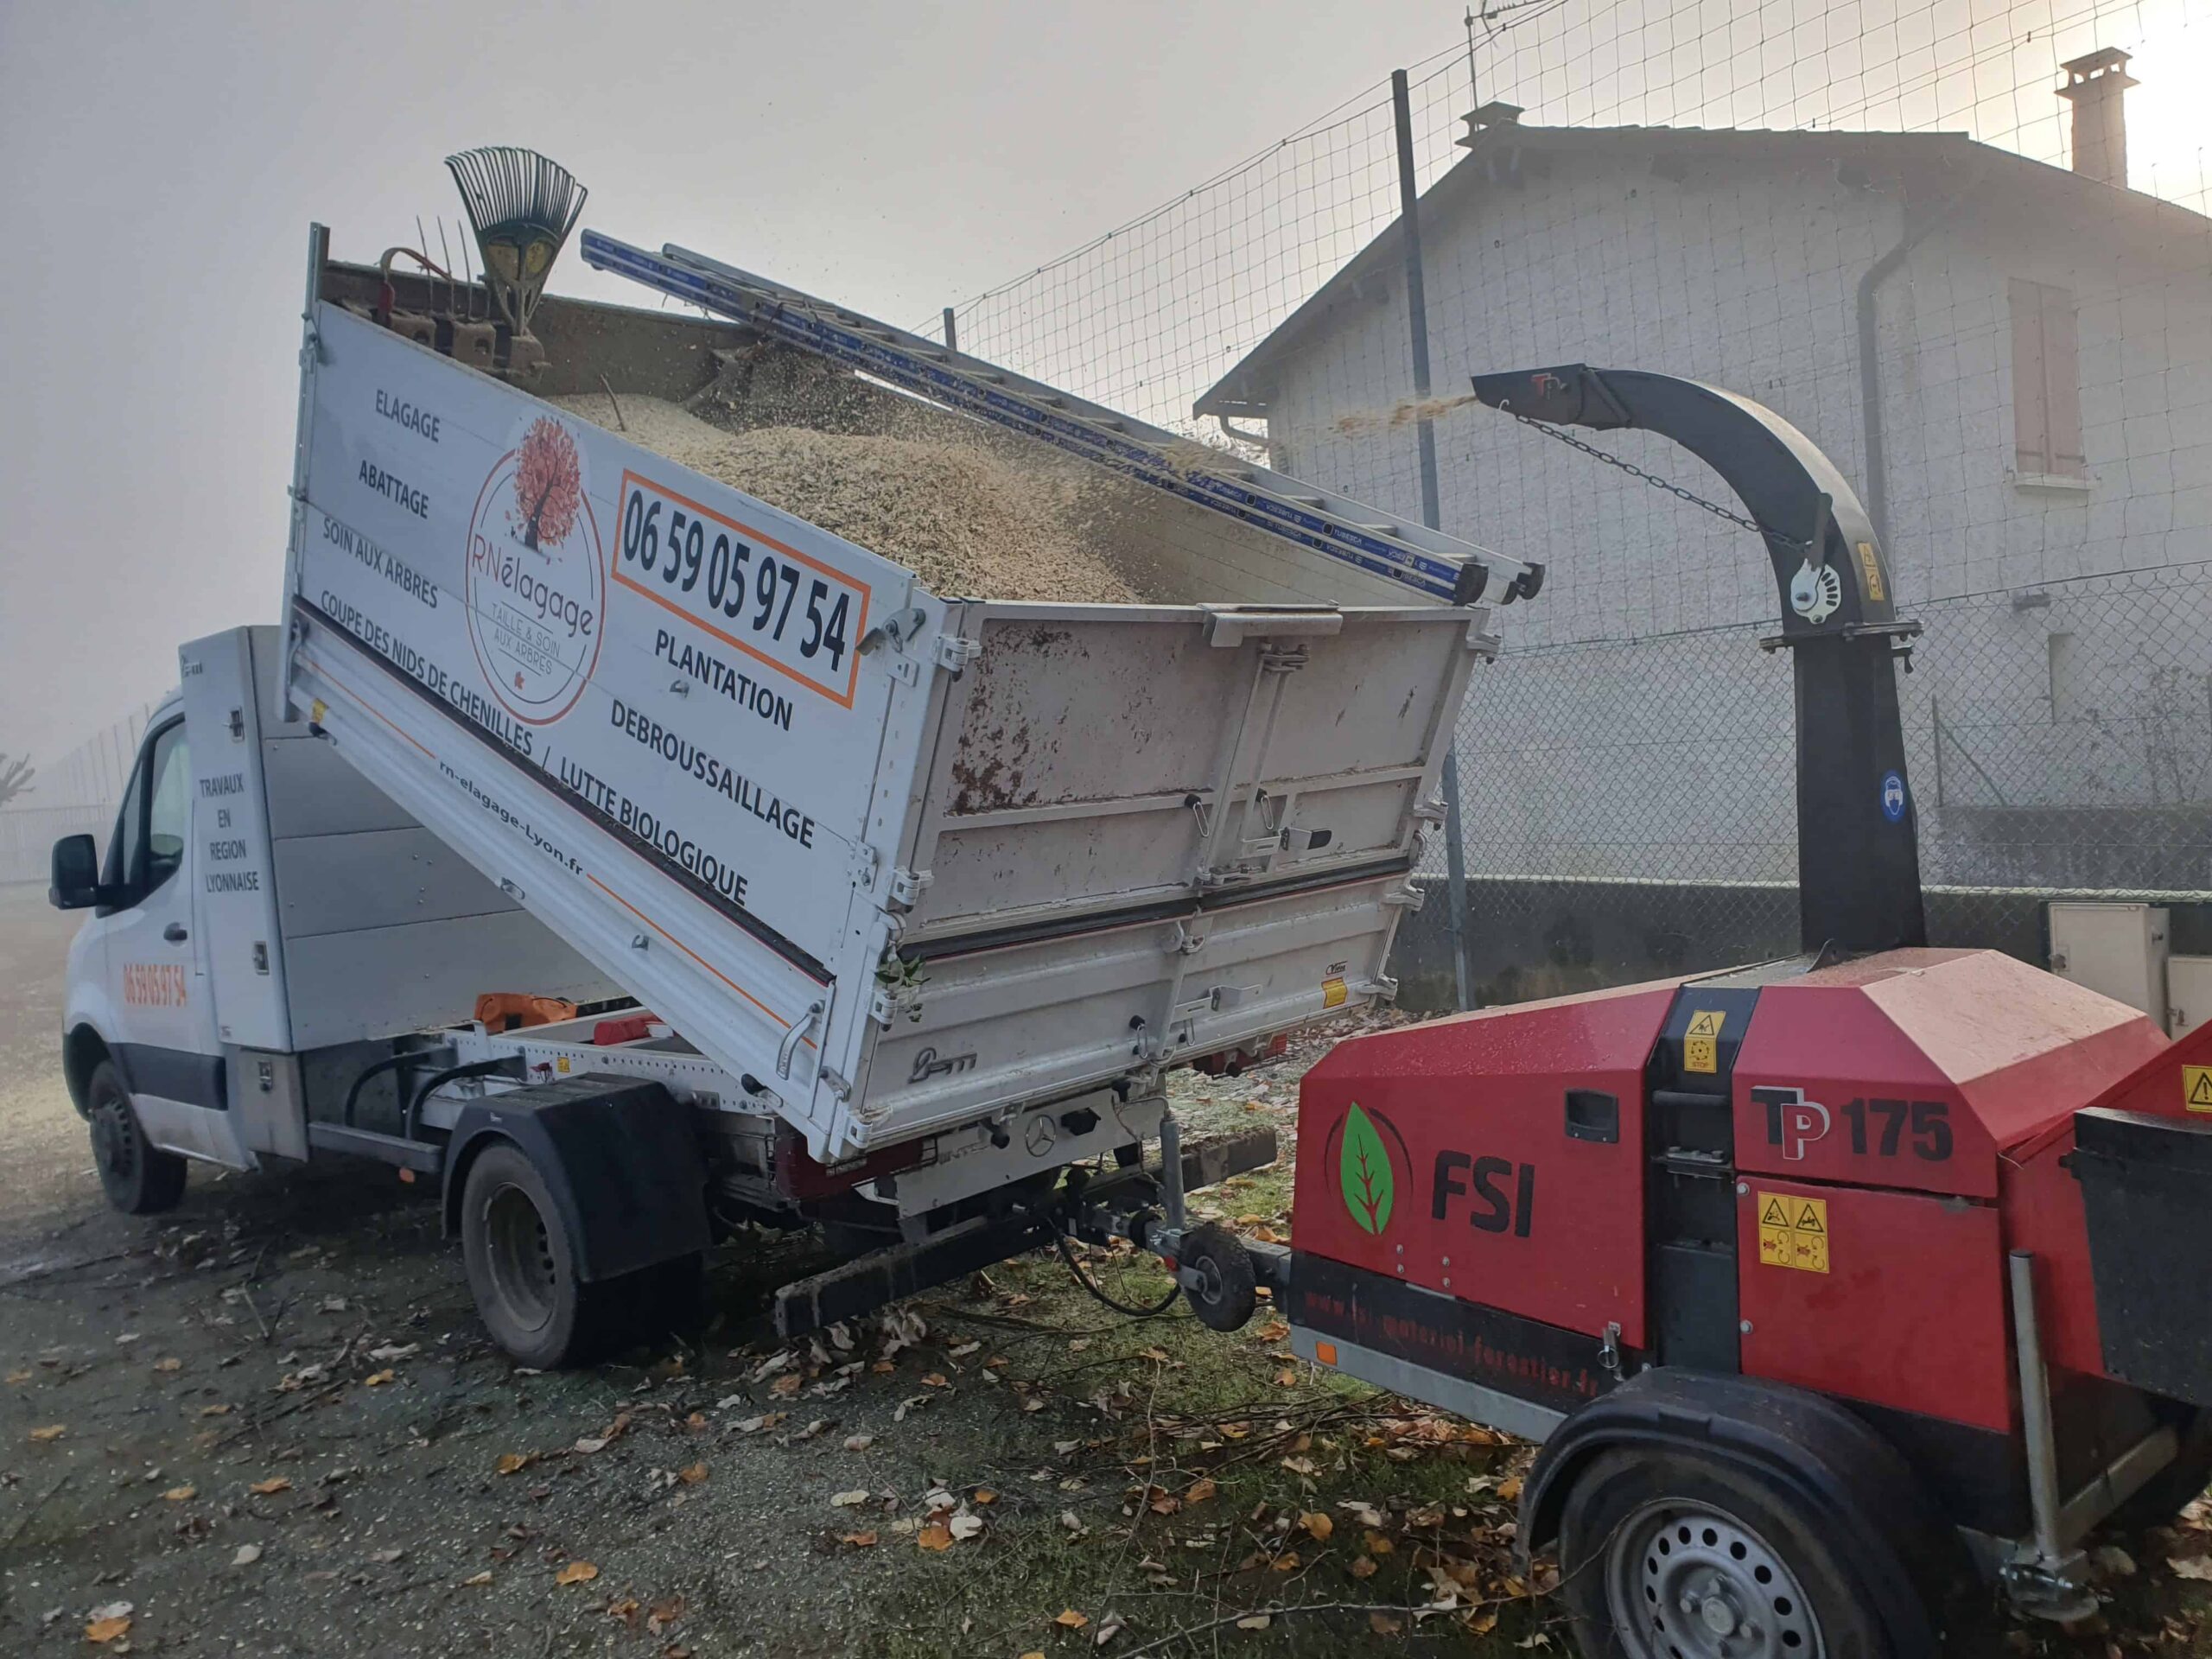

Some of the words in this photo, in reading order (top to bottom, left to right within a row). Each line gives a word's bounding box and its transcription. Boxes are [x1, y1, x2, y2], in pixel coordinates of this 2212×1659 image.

[376, 389, 440, 443] ELAGAGE
[359, 460, 429, 519] ABATTAGE
[323, 517, 353, 554] SOIN
[355, 539, 381, 574] AUX
[385, 558, 438, 608] ARBRES
[624, 490, 661, 571] 06
[663, 510, 703, 592] 59
[708, 533, 750, 618] 05
[753, 556, 800, 642] 97
[800, 579, 849, 672] 54
[493, 602, 523, 636] TAILLE
[527, 626, 532, 640] &
[536, 632, 561, 658] SOIN
[494, 628, 512, 648] AUX
[516, 642, 552, 675] ARBRES
[655, 629, 793, 731] PLANTATION
[321, 590, 362, 635] COUPE
[365, 620, 390, 654] DES
[392, 638, 425, 678] NIDS
[428, 664, 448, 696] DE
[450, 681, 532, 756] CHENILLES
[542, 746, 550, 771] /
[561, 756, 616, 816] LUTTE
[620, 798, 748, 906] BIOLOGIQUE
[611, 699, 815, 849] DEBROUSSAILLAGE
[200, 773, 245, 798] TRAVAUX
[218, 809, 231, 828] EN
[440, 761, 583, 876] rn-elagage-Lyon.fr
[209, 839, 247, 861] REGION
[206, 871, 259, 893] LYONNAISE
[1840, 1097, 1954, 1161] 175
[1432, 1149, 1535, 1237] FSI
